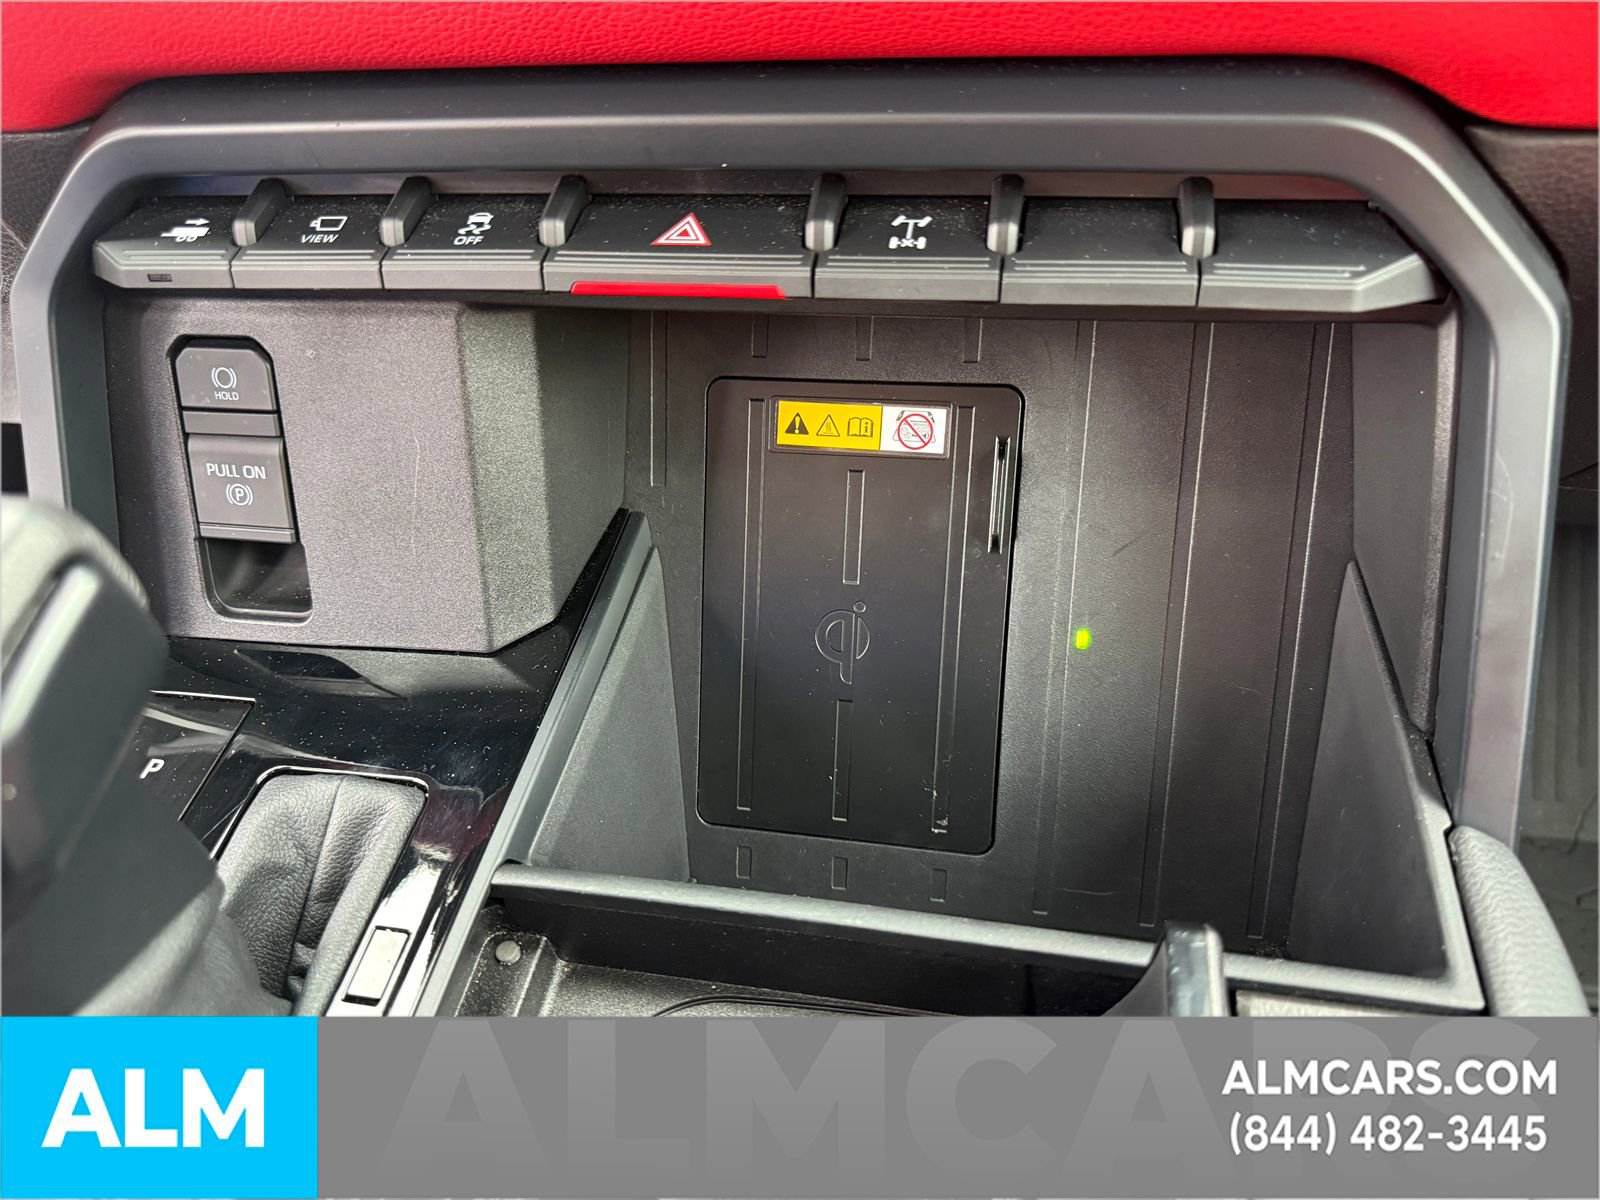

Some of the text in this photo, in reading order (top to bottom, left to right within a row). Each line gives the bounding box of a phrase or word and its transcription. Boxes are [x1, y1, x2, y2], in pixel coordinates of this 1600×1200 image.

[301, 234, 340, 244] VIEW
[453, 236, 484, 245] OFF
[214, 391, 239, 401] HOLD
[206, 463, 267, 479] PULL ON
[139, 758, 165, 779] P
